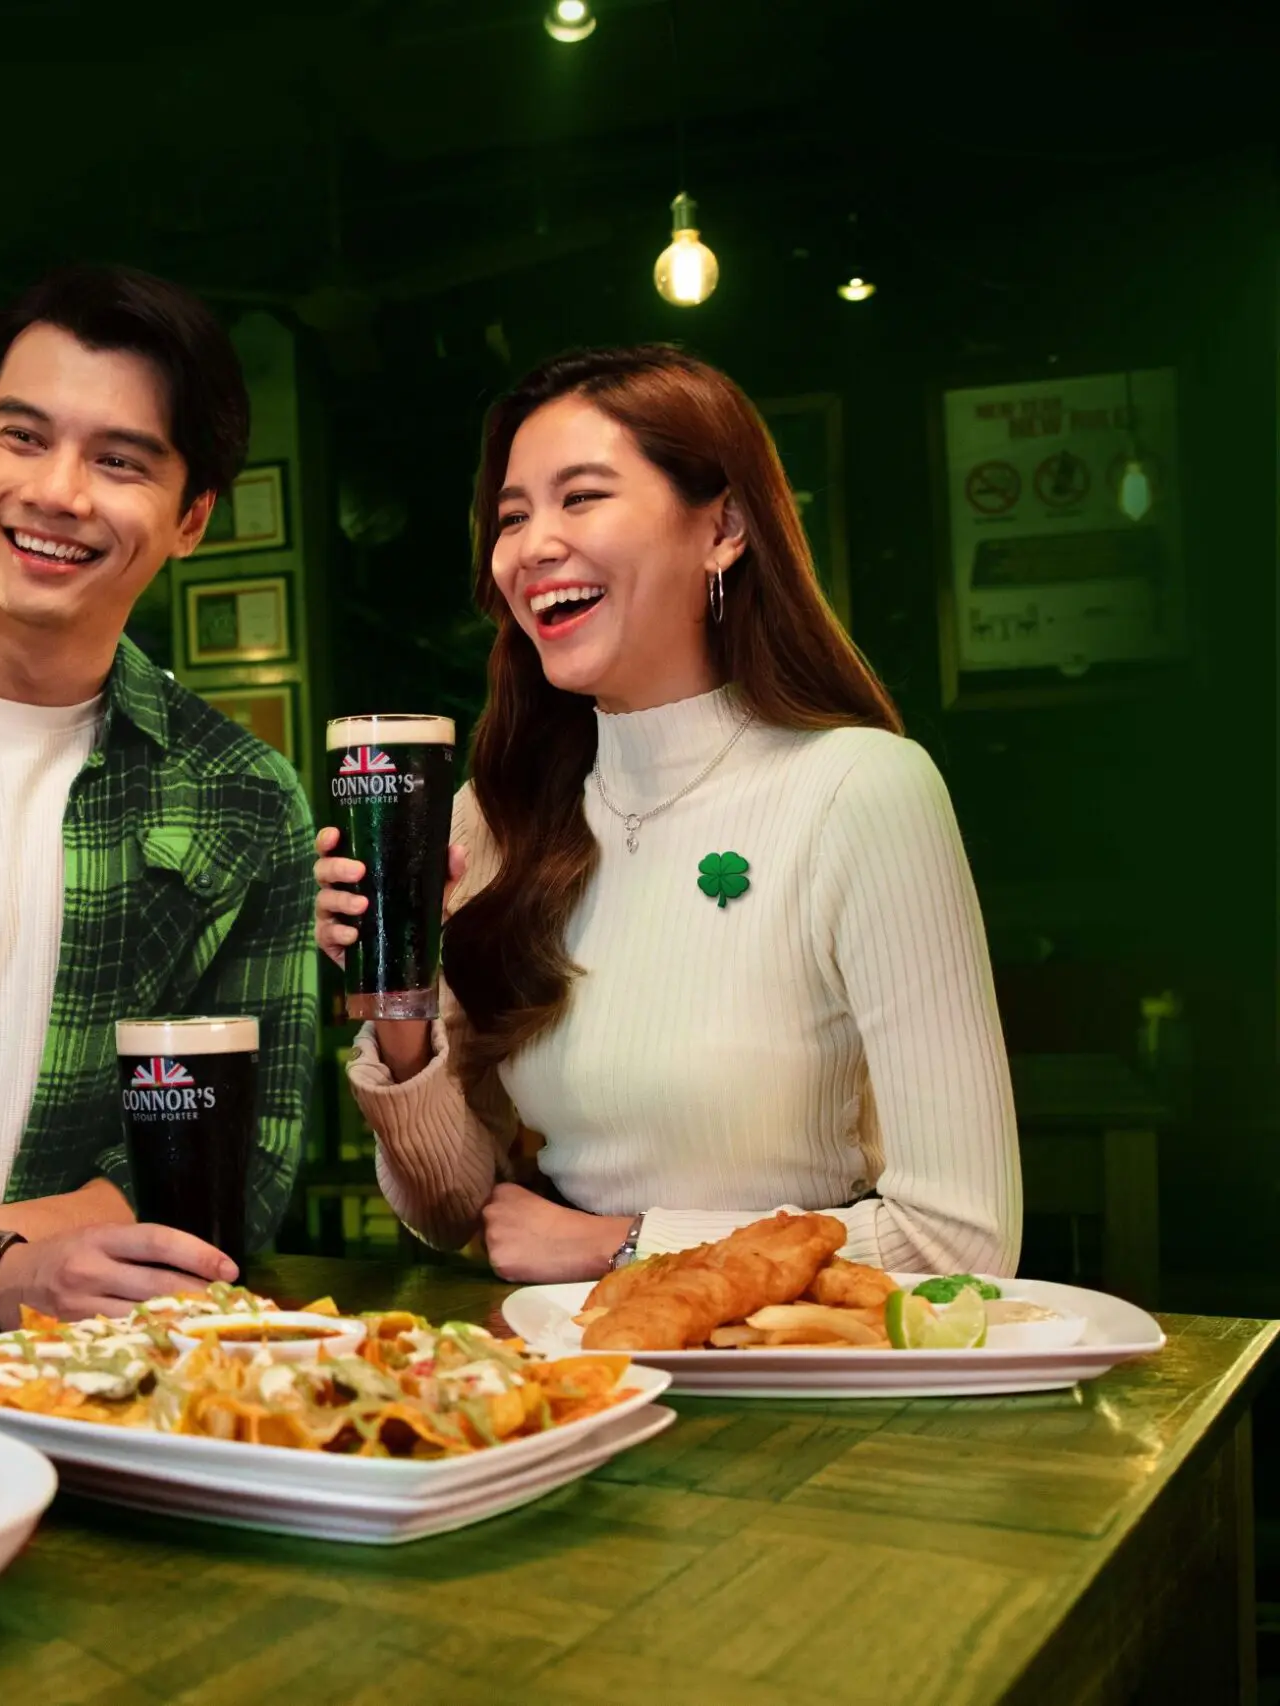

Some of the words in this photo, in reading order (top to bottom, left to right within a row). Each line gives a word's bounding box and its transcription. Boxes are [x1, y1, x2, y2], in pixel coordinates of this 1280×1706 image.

[332, 774, 415, 797] CONNOR'S
[340, 796, 361, 806] STOUT
[365, 794, 399, 804] PORTER
[122, 1087, 216, 1111] CONNOR'S
[133, 1112, 157, 1122] STOUT
[161, 1111, 199, 1121] PORTER
